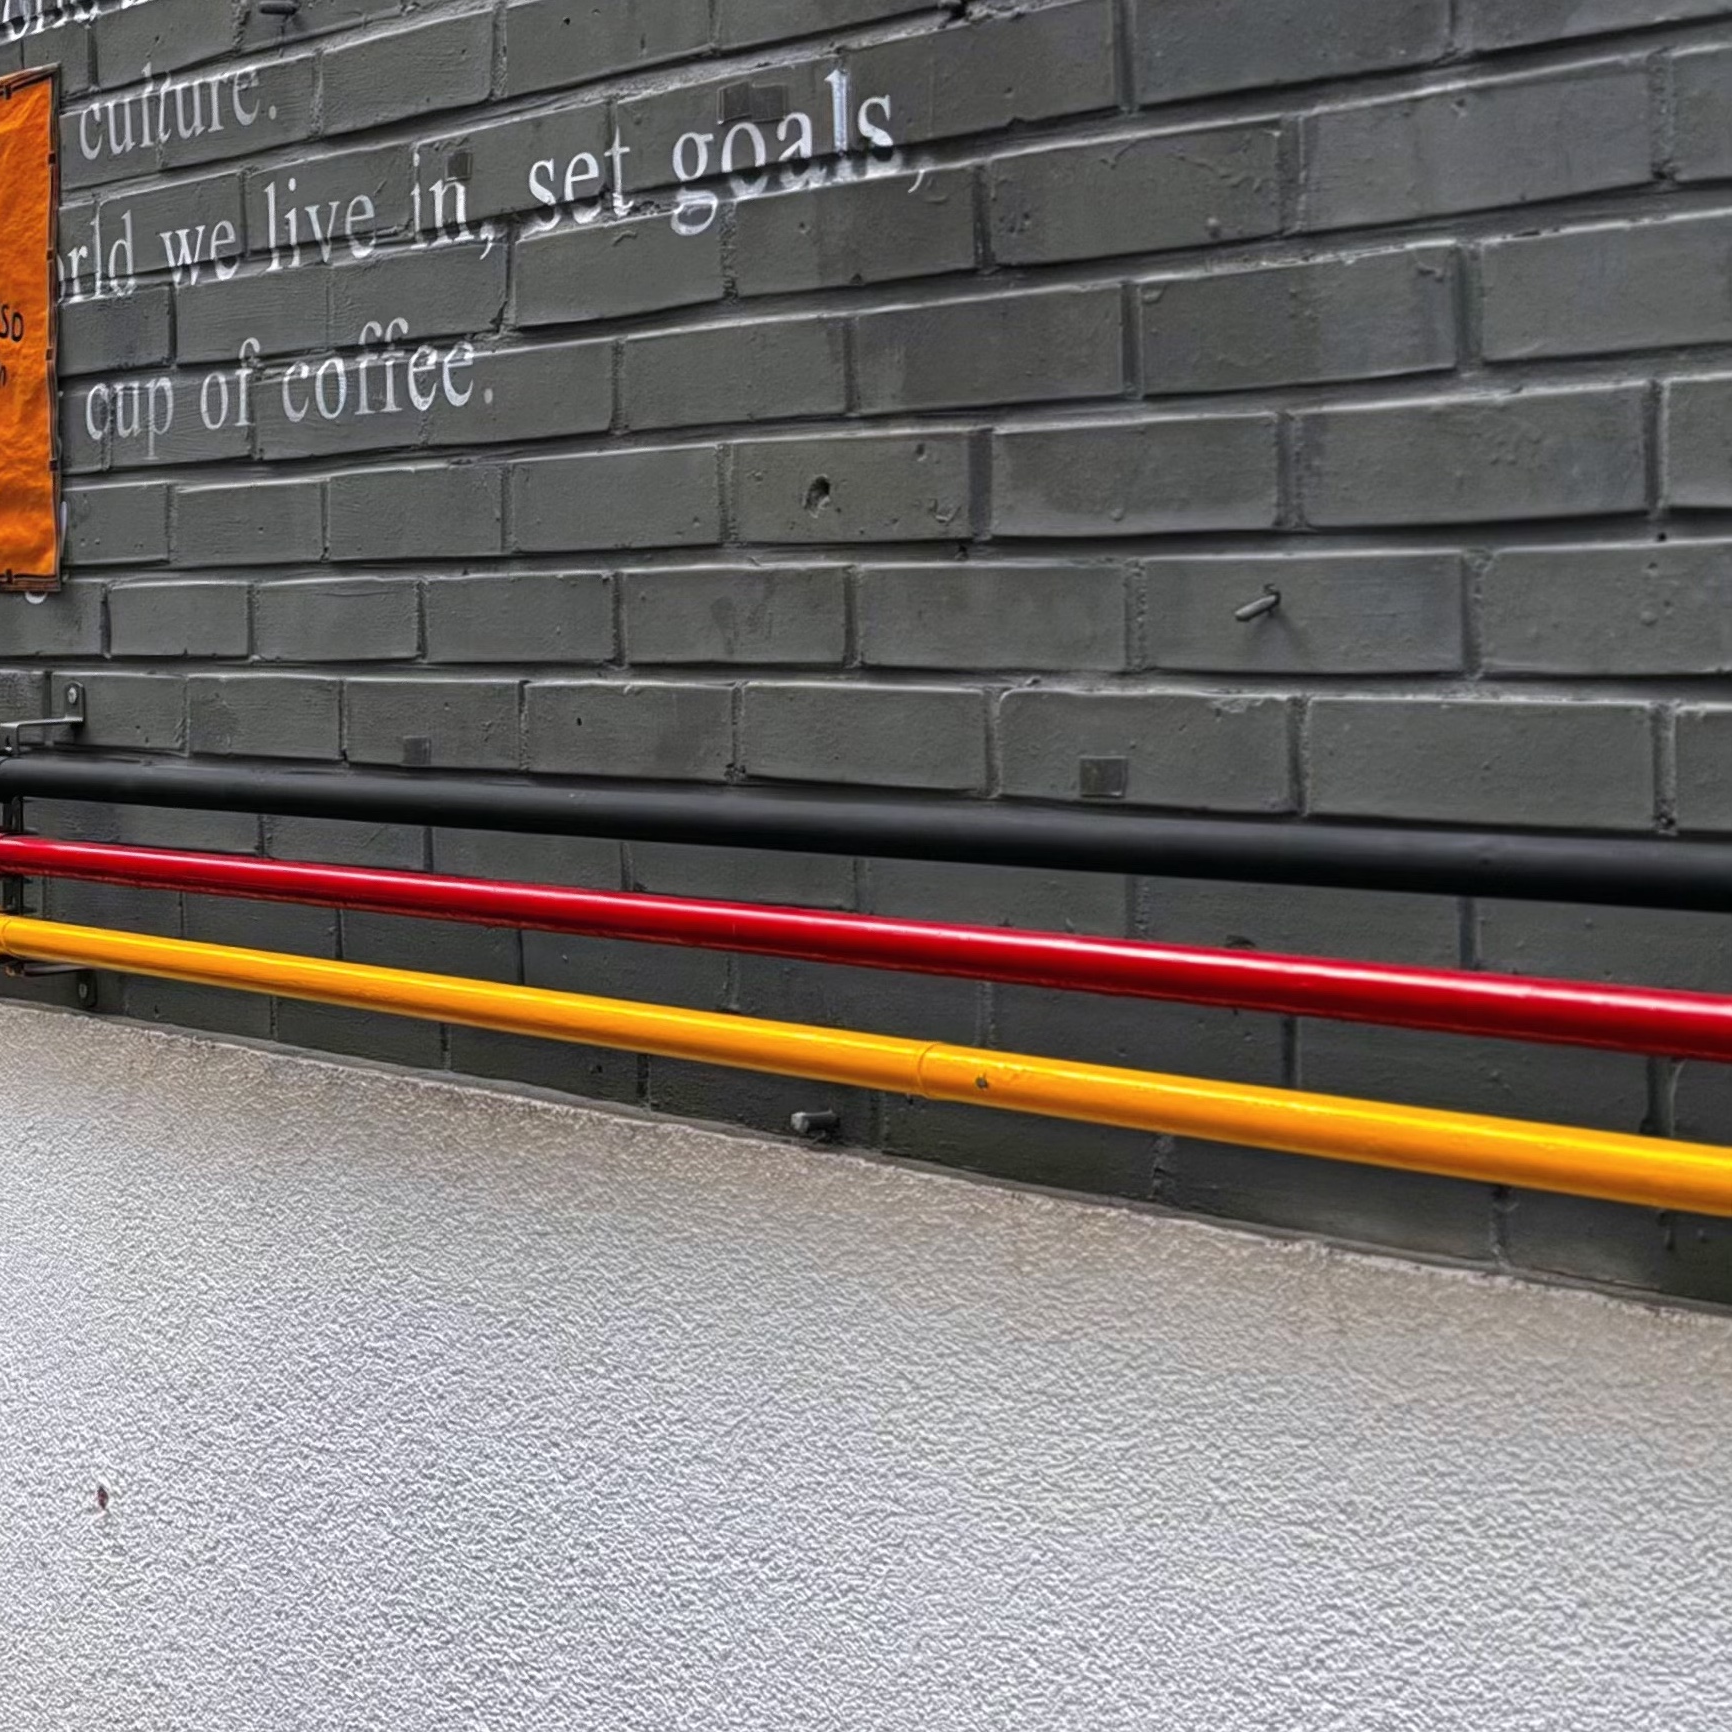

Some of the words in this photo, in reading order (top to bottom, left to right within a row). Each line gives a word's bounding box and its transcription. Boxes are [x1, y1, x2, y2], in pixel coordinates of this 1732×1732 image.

[79, 62, 277, 160] culture.
[160, 219, 240, 287] we
[264, 177, 377, 272] live
[408, 150, 496, 261] in,
[528, 125, 634, 232] set
[671, 68, 926, 236] goals,
[85, 374, 173, 461] cup
[201, 337, 261, 431] of
[282, 316, 495, 424] coffee.
